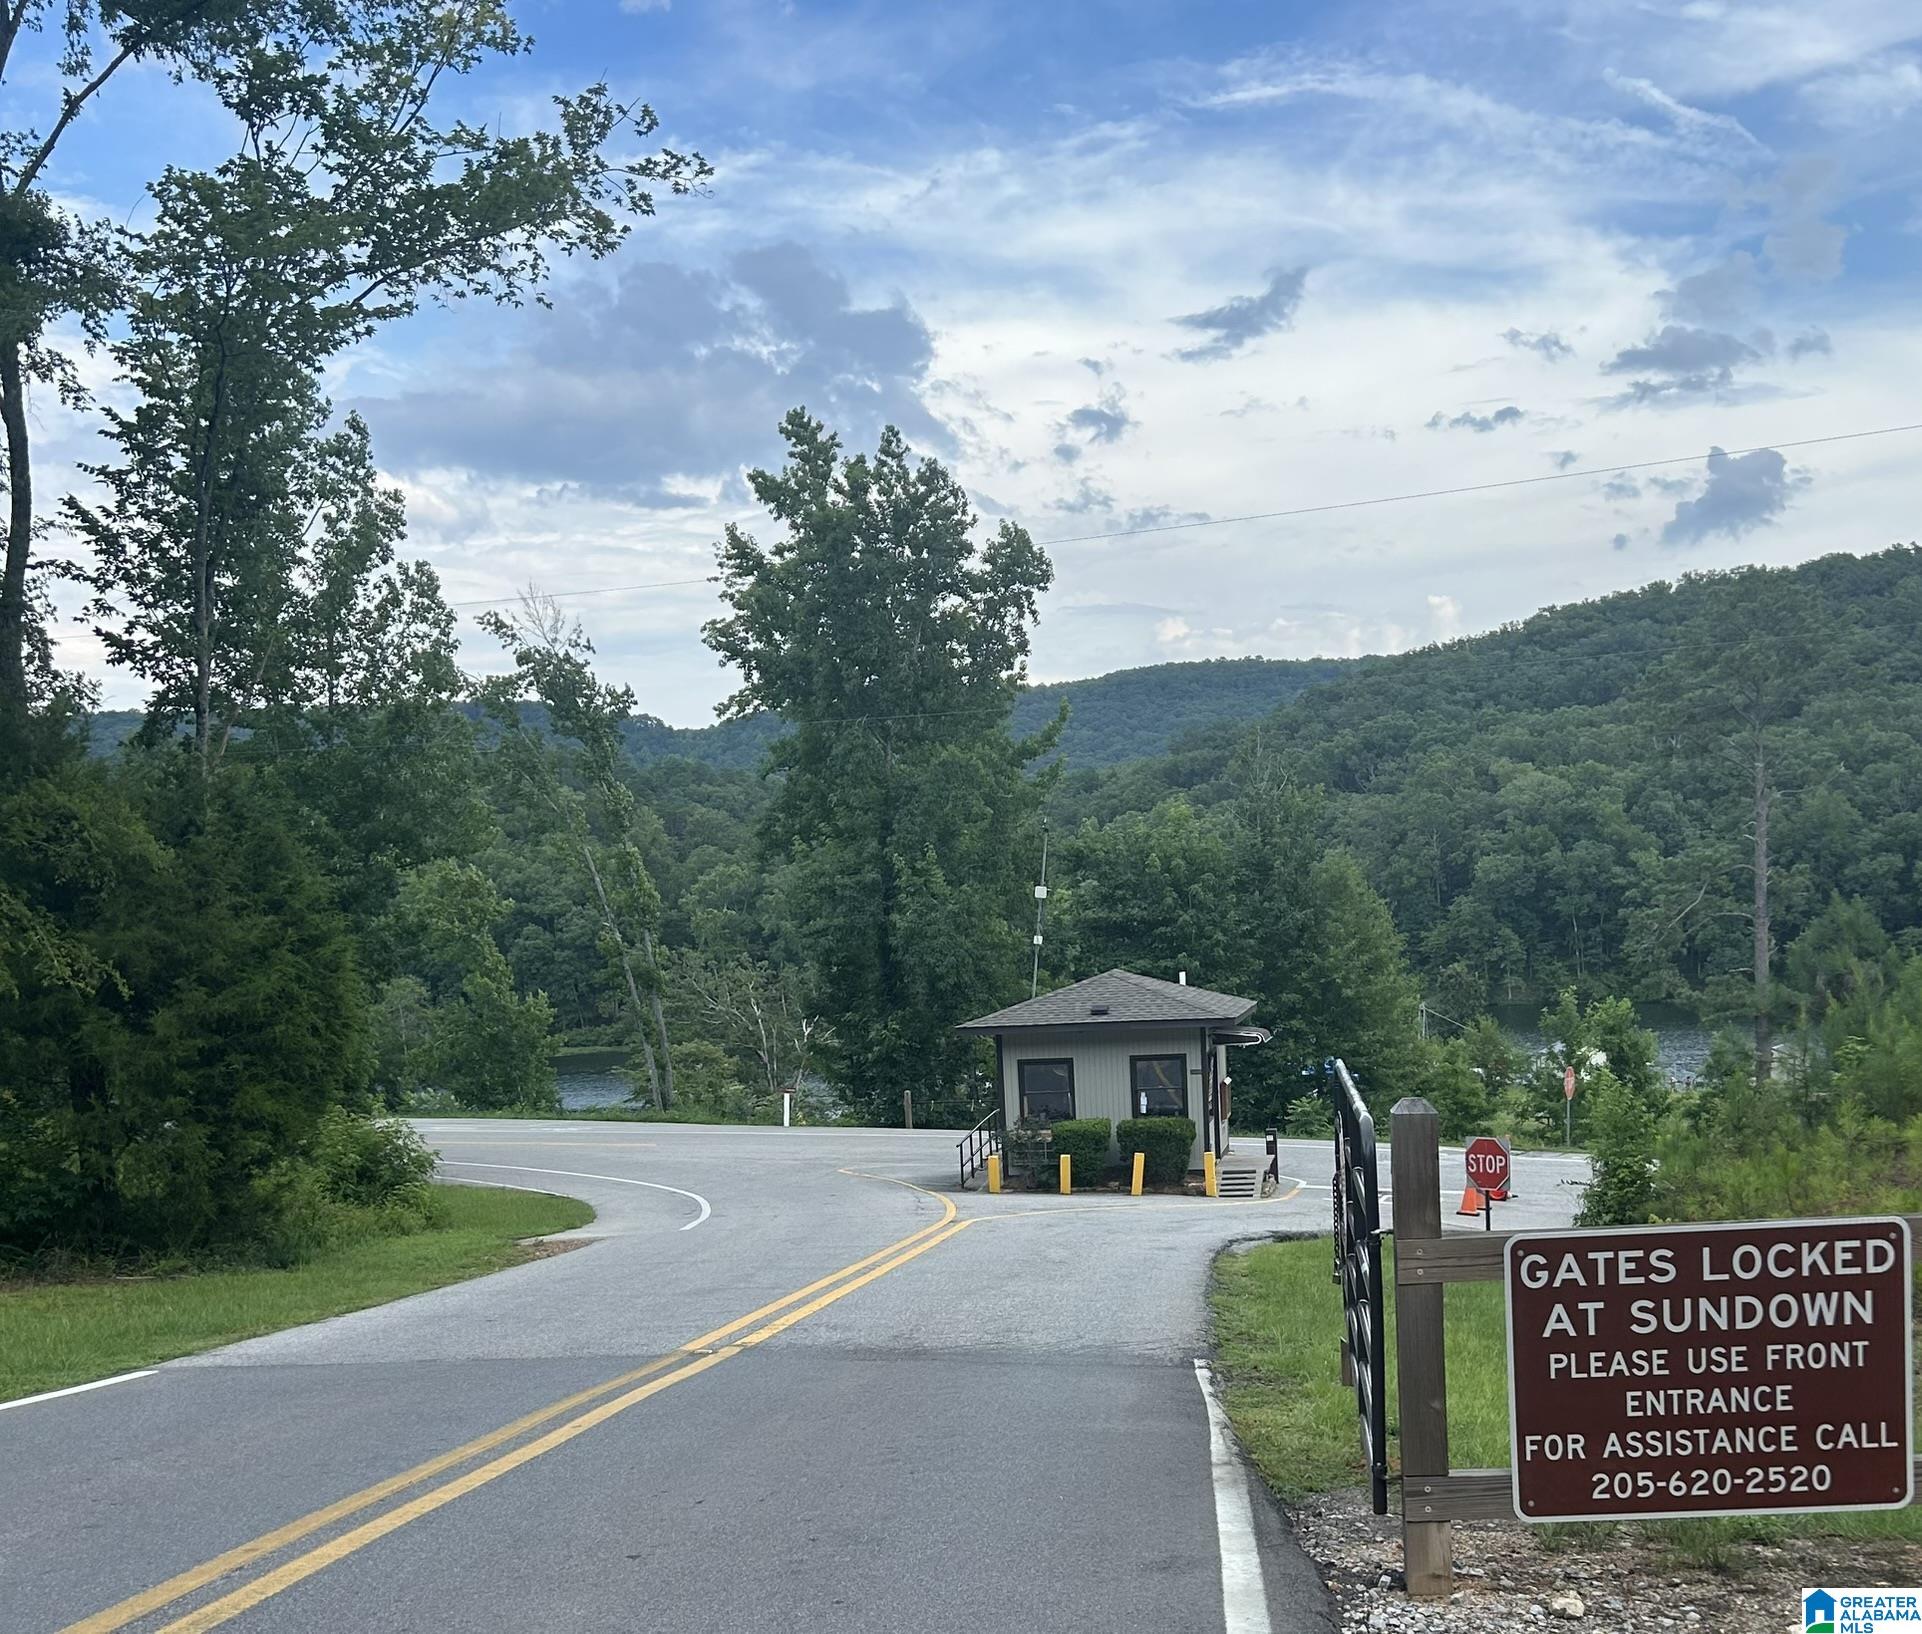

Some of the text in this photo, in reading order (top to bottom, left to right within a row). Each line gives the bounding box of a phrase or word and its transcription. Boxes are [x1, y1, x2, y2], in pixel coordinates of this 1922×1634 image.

[1468, 1154, 1506, 1174] STOP
[1519, 1239, 1895, 1288] GATES LOCKED
[1542, 1290, 1874, 1337] AT SUNDOWN
[1550, 1341, 1869, 1379] PLEASE USE FRONT
[1626, 1385, 1793, 1417] ENTRANCE
[1525, 1422, 1898, 1461] FOR ASSISTANCE CALL
[1591, 1465, 1832, 1499] 205-620-2520
